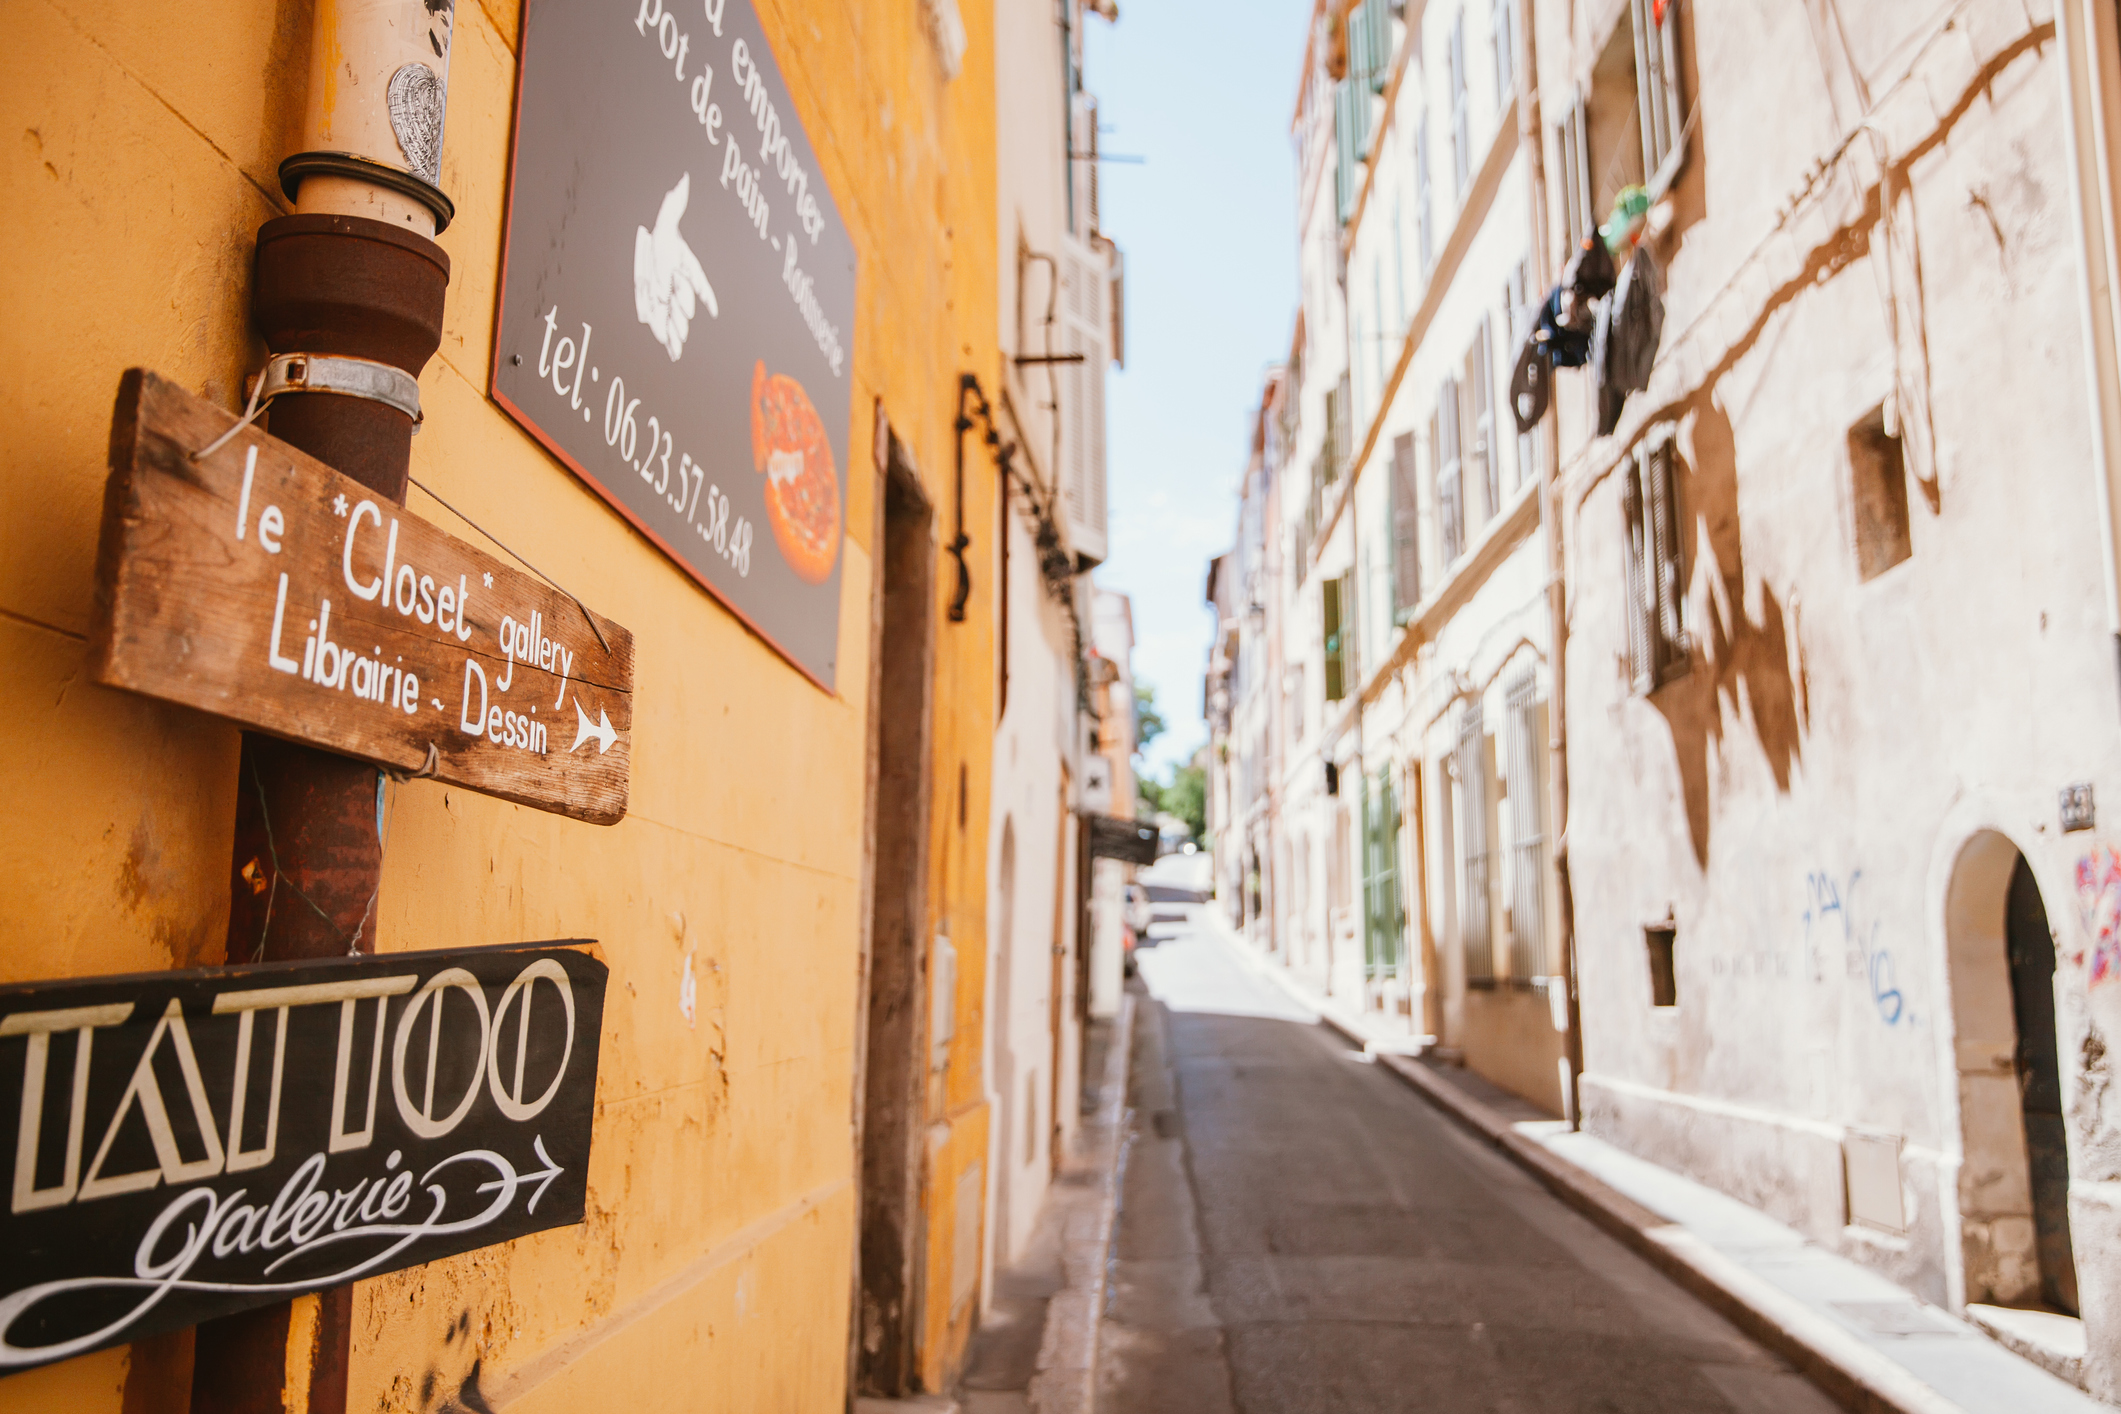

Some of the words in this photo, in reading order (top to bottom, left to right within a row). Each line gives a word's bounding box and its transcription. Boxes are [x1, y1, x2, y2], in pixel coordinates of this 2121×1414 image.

[634, 0, 690, 82] pot
[691, 63, 722, 145] de
[719, 132, 769, 240] pain
[732, 38, 824, 245] emporter
[538, 304, 599, 422] tel:
[604, 376, 753, 578] 06.23.57.58.48
[235, 445, 285, 554] le
[496, 610, 573, 711] gallery
[268, 573, 419, 715] Librairie
[460, 658, 548, 755] Dessin
[0, 958, 576, 1215] TATTOO
